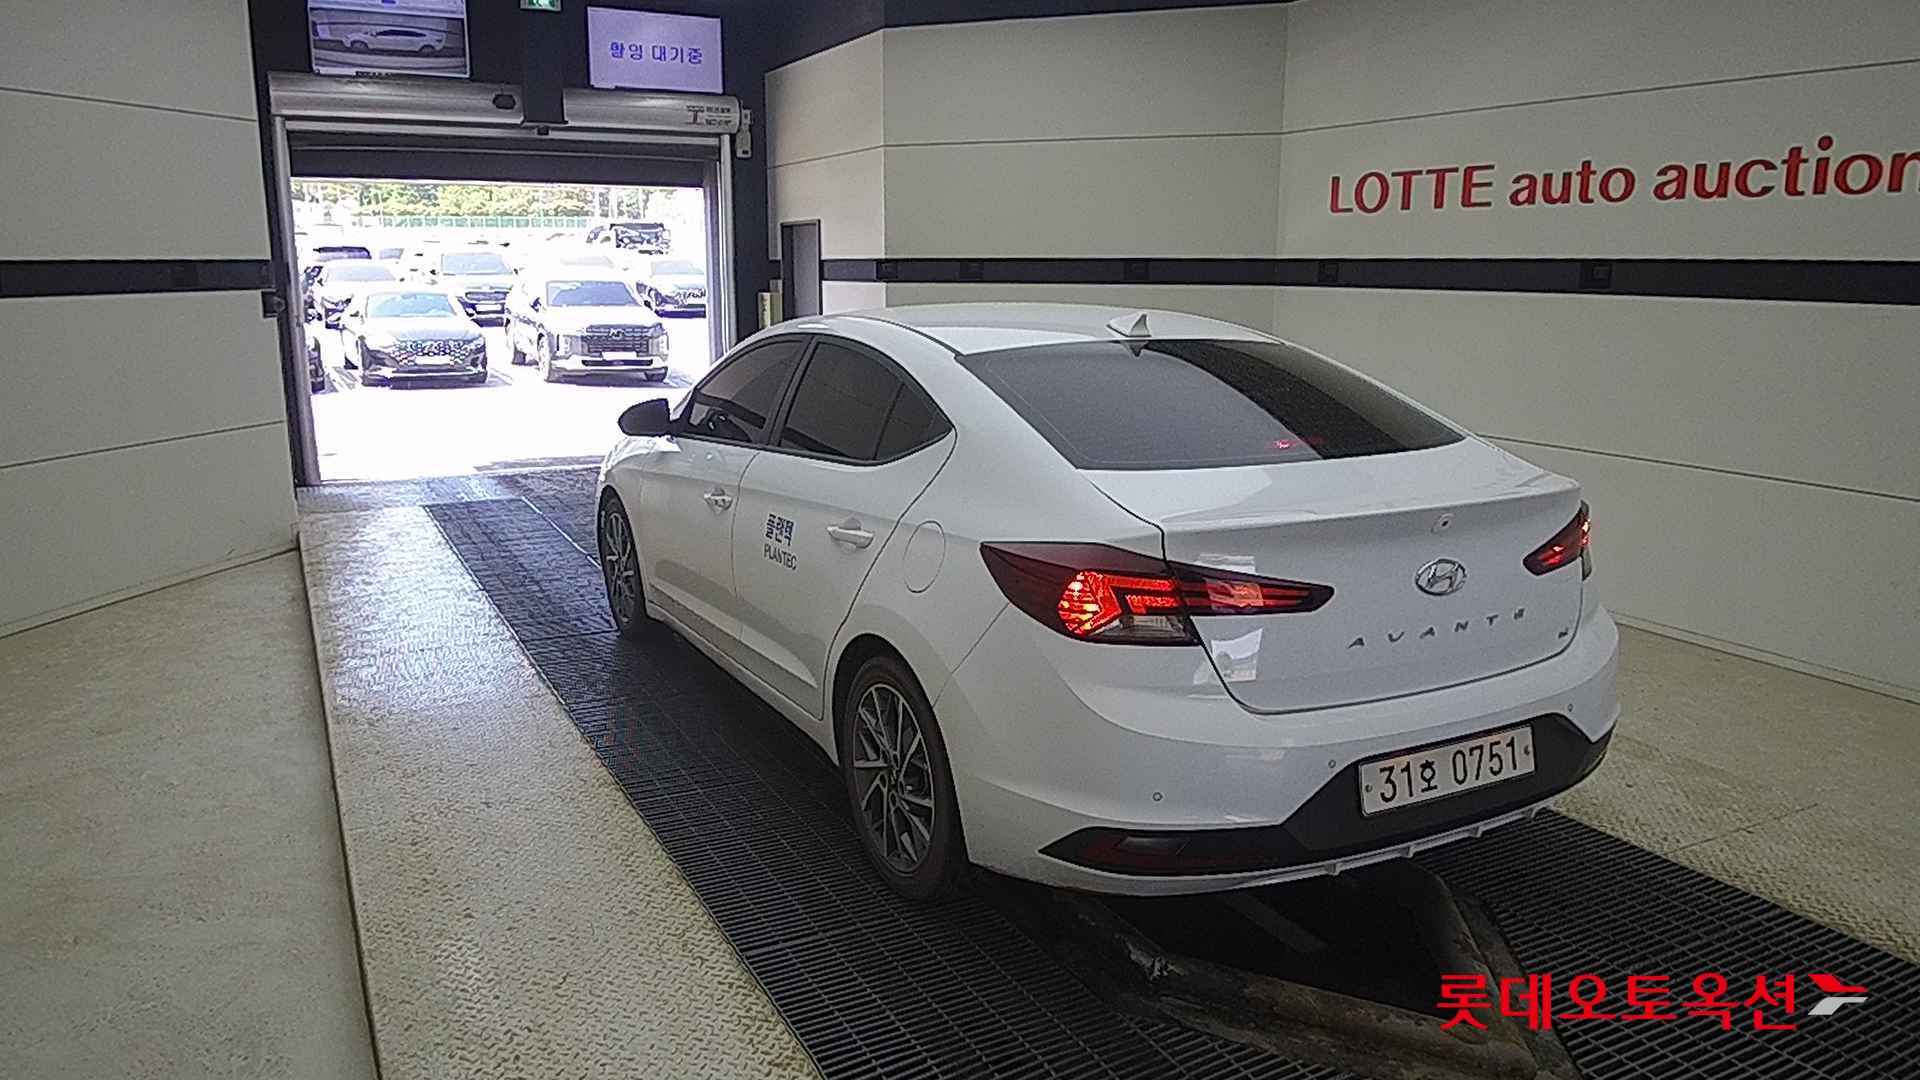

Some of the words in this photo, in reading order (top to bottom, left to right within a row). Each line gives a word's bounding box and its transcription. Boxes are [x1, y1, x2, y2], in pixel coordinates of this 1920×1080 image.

[651, 44, 703, 65] 대기중
[1330, 164, 1495, 214] LOTTE
[1509, 159, 1635, 207] auto
[763, 543, 797, 571] PLANTEC
[1348, 607, 1526, 649] AVANTE
[1378, 759, 1438, 804] 31호
[1451, 736, 1518, 786] 0751
